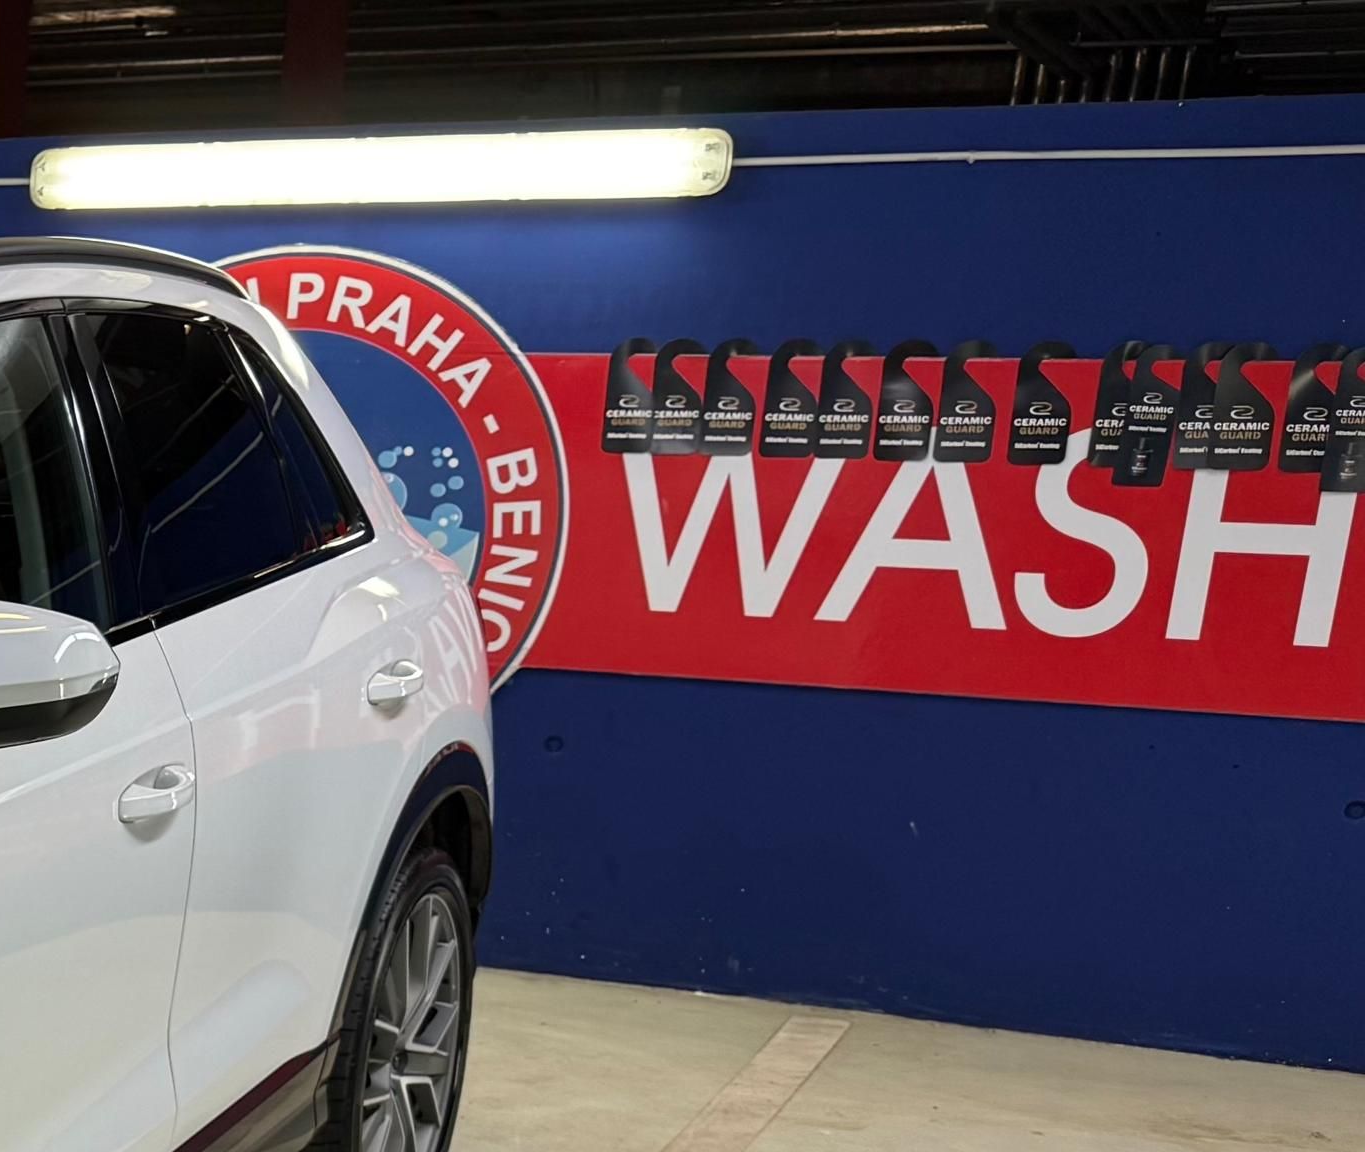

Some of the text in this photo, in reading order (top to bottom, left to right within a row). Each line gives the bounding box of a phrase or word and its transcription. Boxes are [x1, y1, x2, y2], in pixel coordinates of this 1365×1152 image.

[286, 273, 492, 408] PRAHA
[606, 409, 652, 419] CERAMIC
[1129, 405, 1174, 414] CERAMIC
[704, 412, 753, 421] CERAMIC
[765, 413, 814, 422] CERAMIC
[819, 414, 869, 424] CERAMIC
[879, 415, 930, 425] CERAMIC
[940, 416, 992, 426] CERAMIC
[1134, 413, 1167, 421] GUARD
[611, 418, 646, 427] GUARD
[709, 420, 746, 429] GUARD
[770, 422, 807, 431] GUARD
[1014, 417, 1067, 427] CERAMIC
[1214, 422, 1270, 431] CERAMIC
[824, 423, 862, 432] GUARD
[884, 424, 922, 433] GUARD
[946, 425, 985, 434] GUARD
[1019, 426, 1059, 435] GUARD
[1220, 431, 1261, 440] GUARD
[623, 427, 1358, 647] WASH
